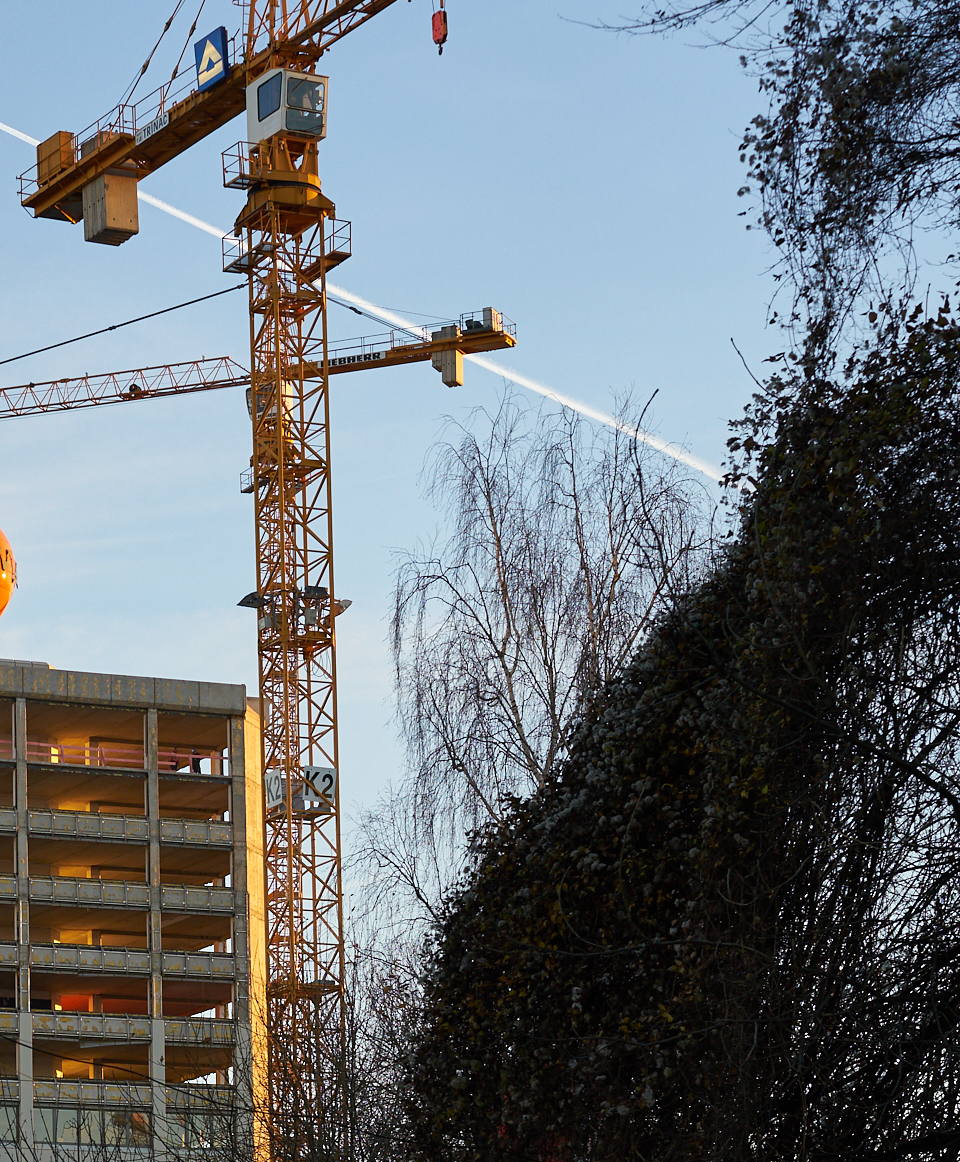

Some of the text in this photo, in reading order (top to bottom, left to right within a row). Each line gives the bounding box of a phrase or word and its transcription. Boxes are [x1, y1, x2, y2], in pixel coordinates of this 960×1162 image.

[143, 115, 167, 139] TRINAC
[266, 775, 281, 803] K2
[305, 771, 334, 798] K2
